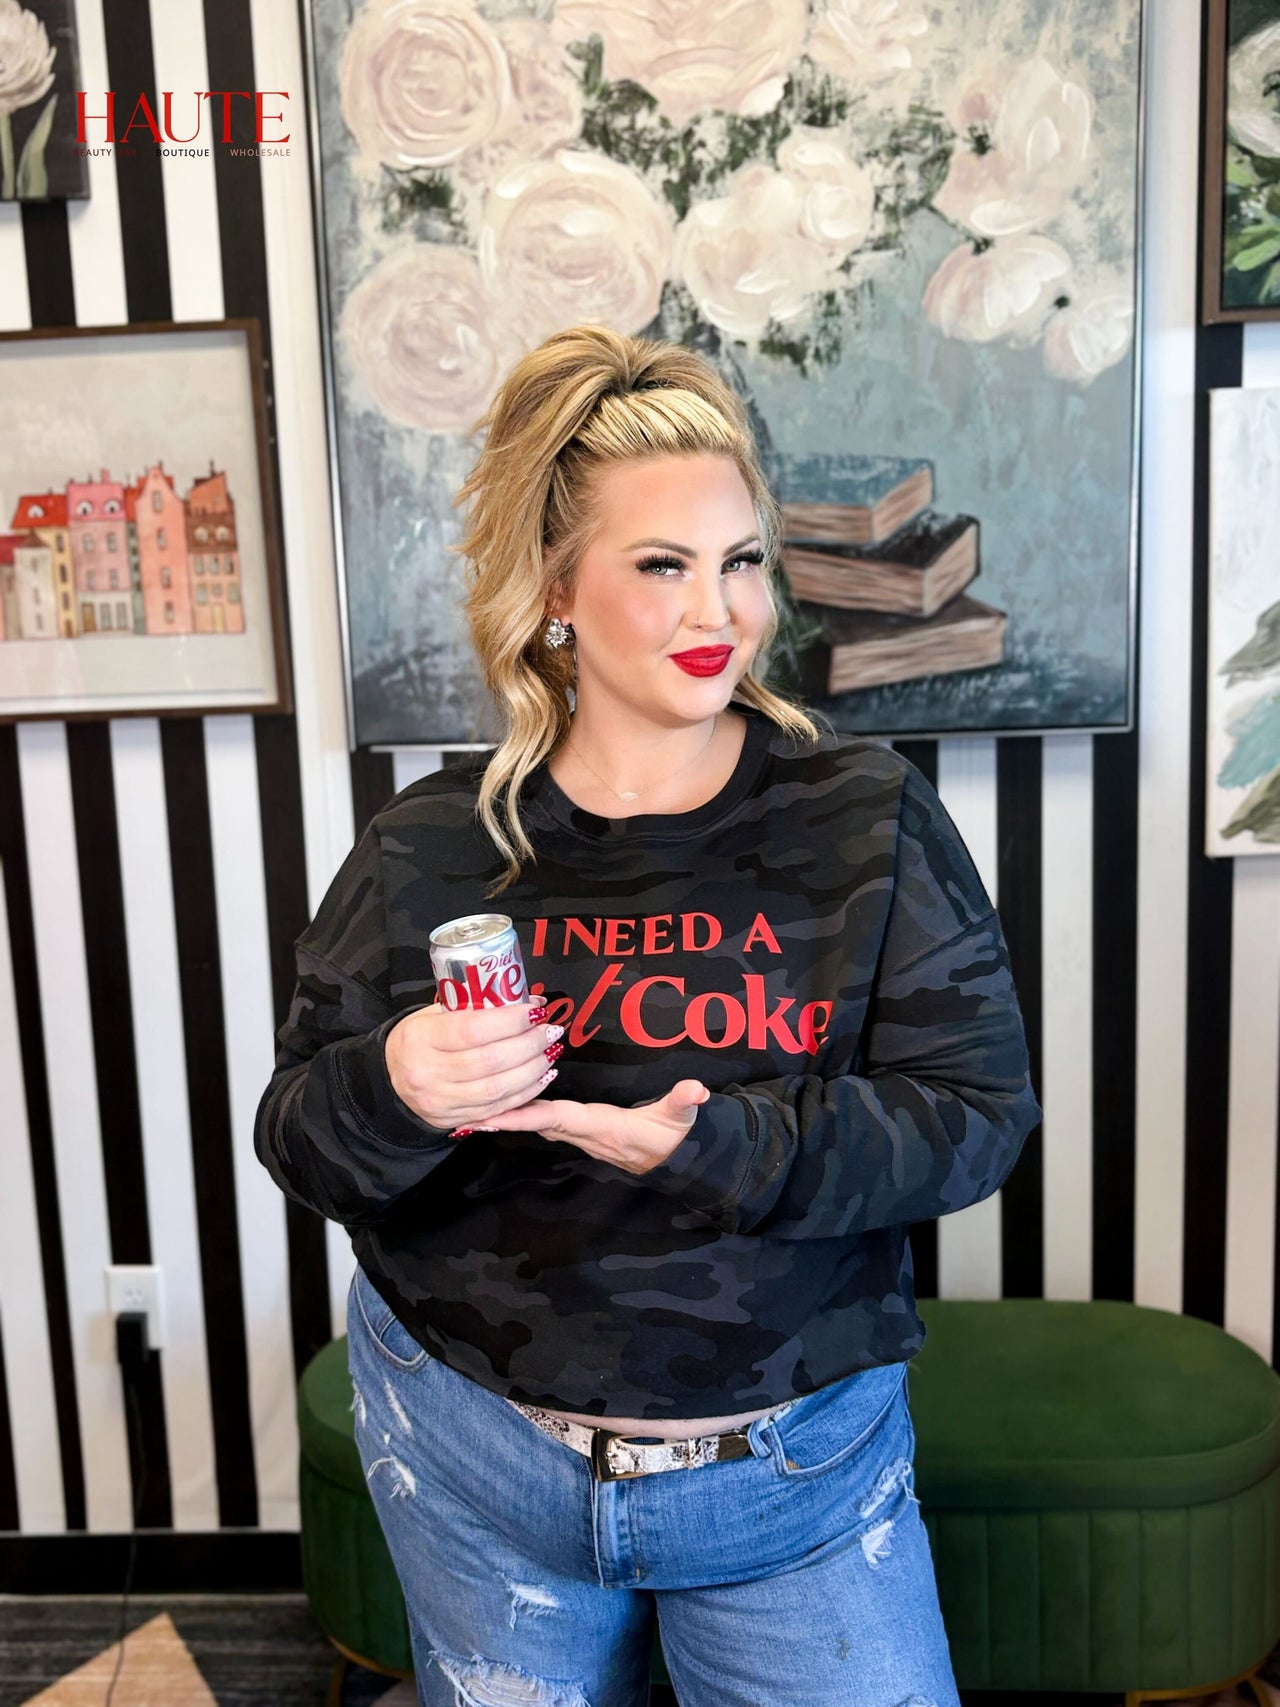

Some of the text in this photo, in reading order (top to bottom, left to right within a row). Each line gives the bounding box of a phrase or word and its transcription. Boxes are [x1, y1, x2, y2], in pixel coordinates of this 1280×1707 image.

[532, 911, 783, 957] I NEED A
[479, 950, 514, 973] Diet
[439, 964, 523, 1011] oke
[619, 974, 834, 1056] Coke
